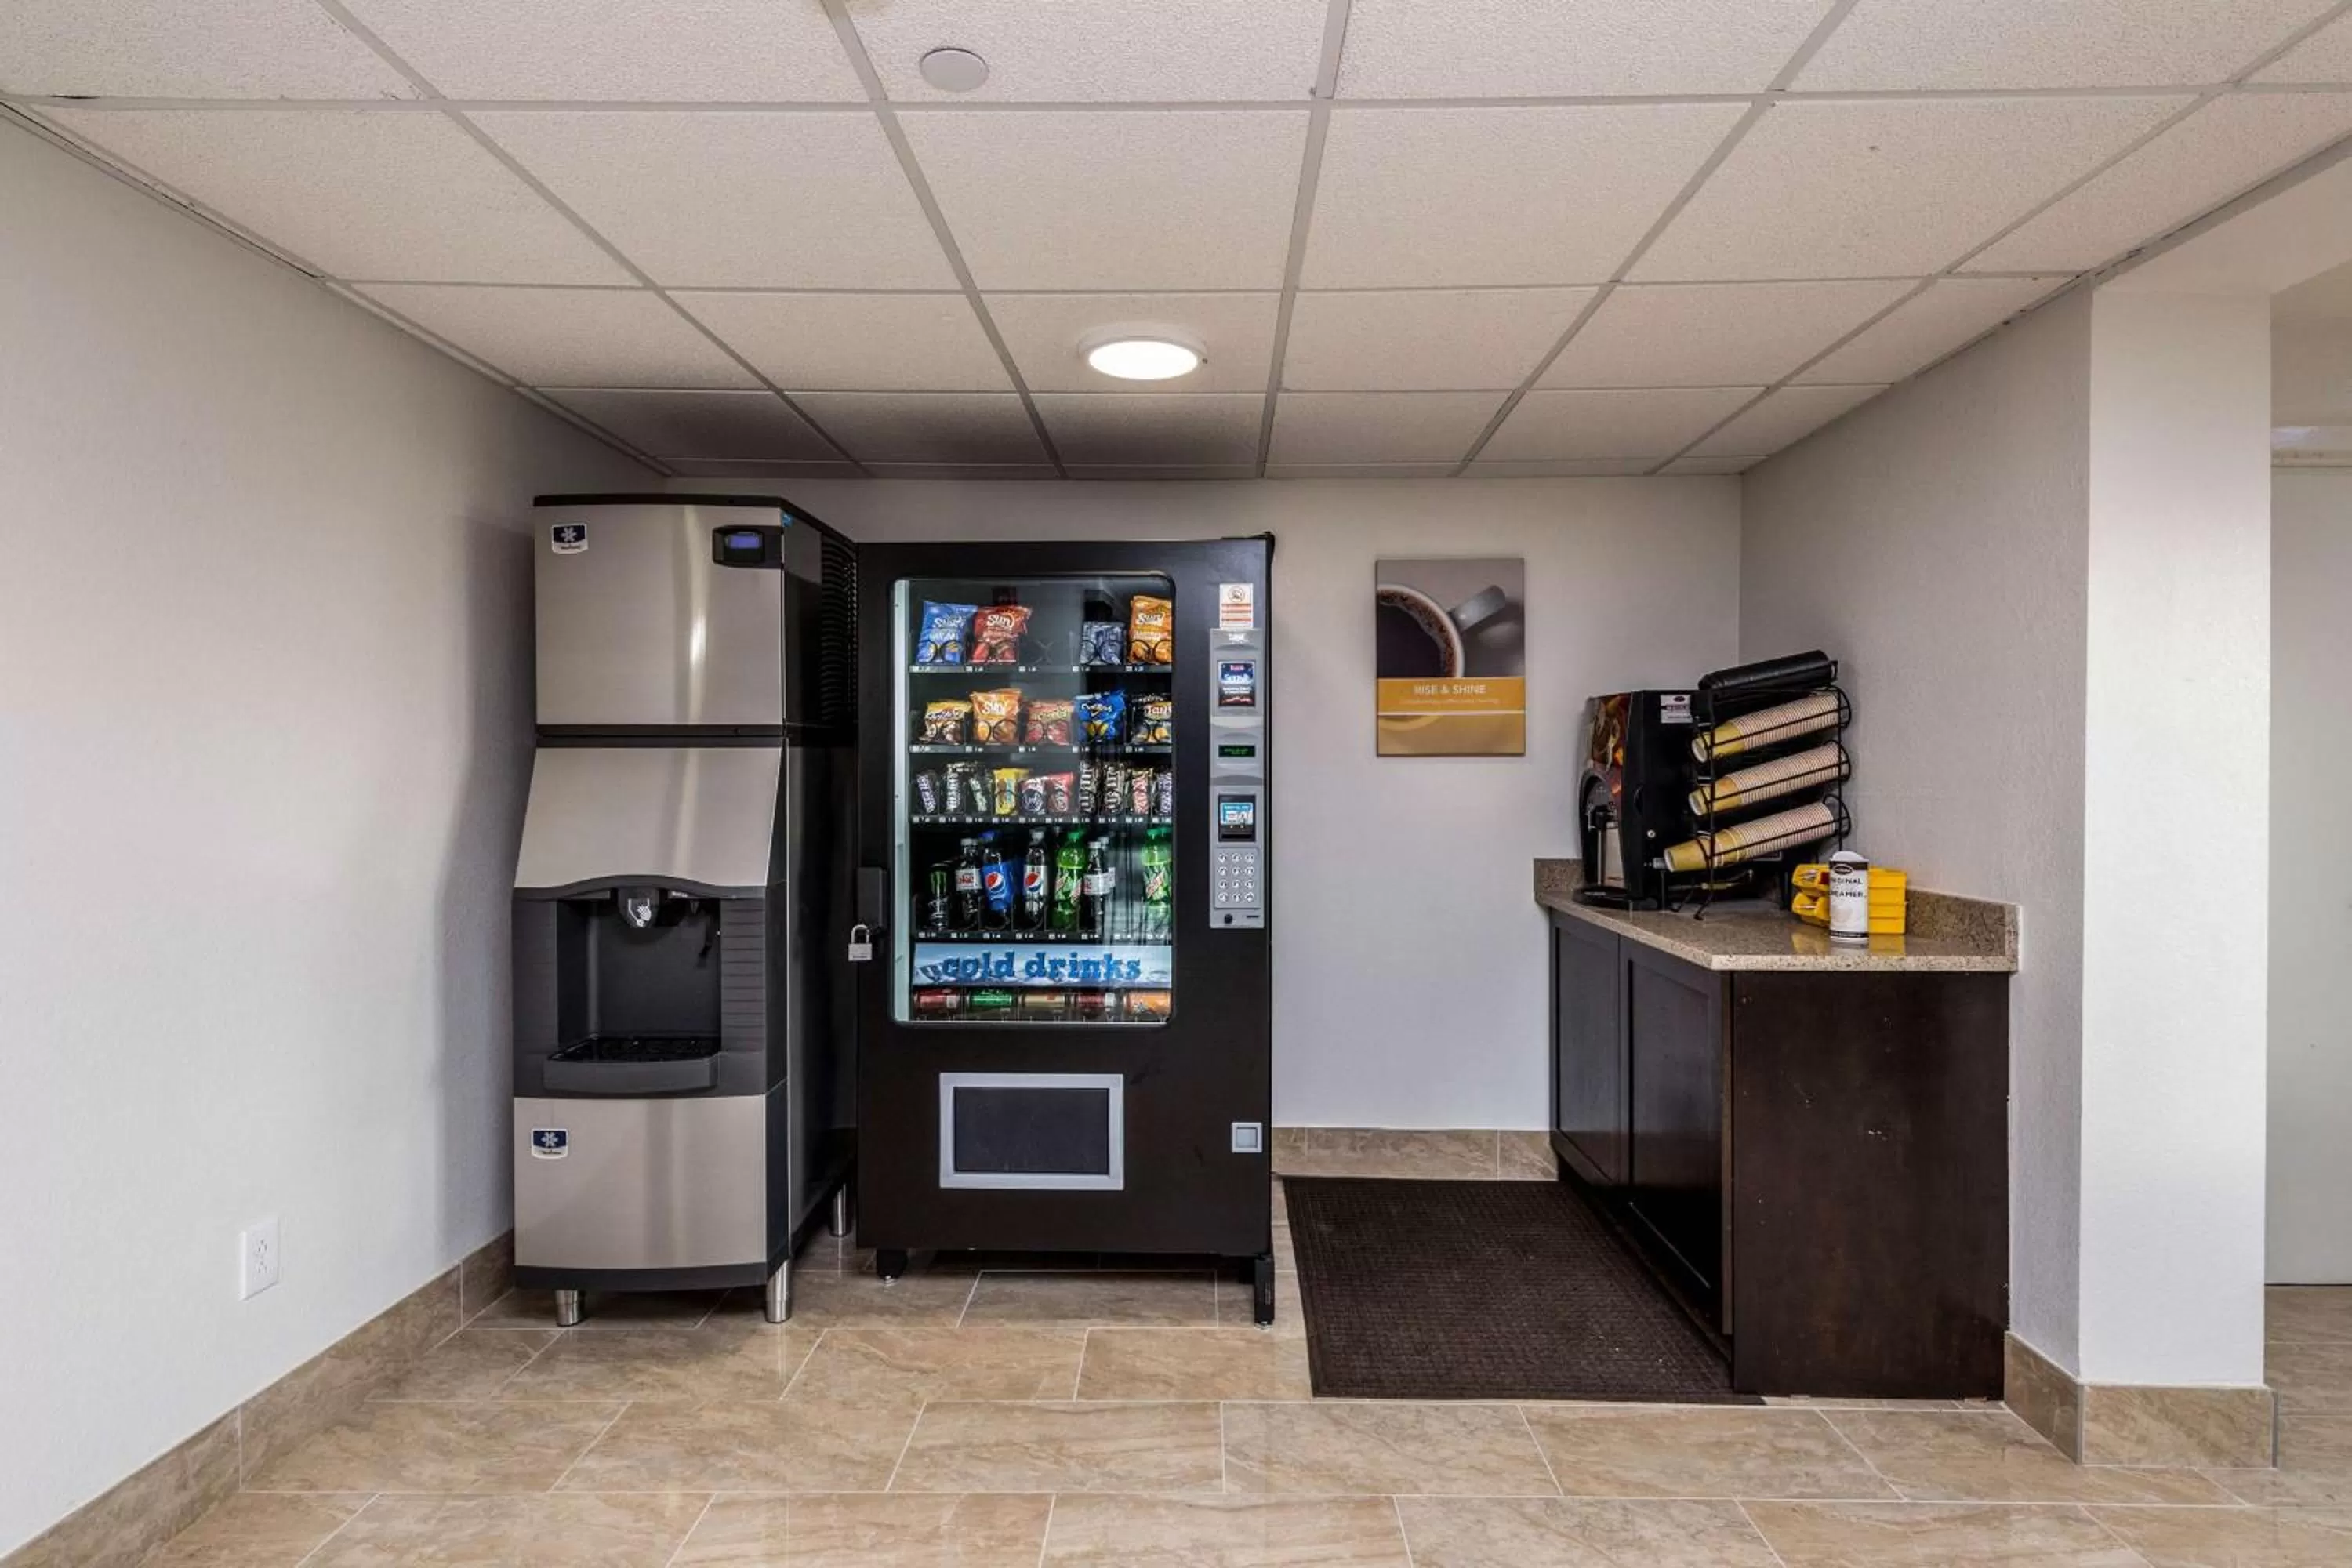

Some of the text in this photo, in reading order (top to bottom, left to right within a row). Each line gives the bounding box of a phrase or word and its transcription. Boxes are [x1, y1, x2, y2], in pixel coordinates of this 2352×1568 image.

[1414, 684, 1437, 695] RISE
[1452, 684, 1486, 694] SHINE
[942, 950, 1141, 980] cold drinks
